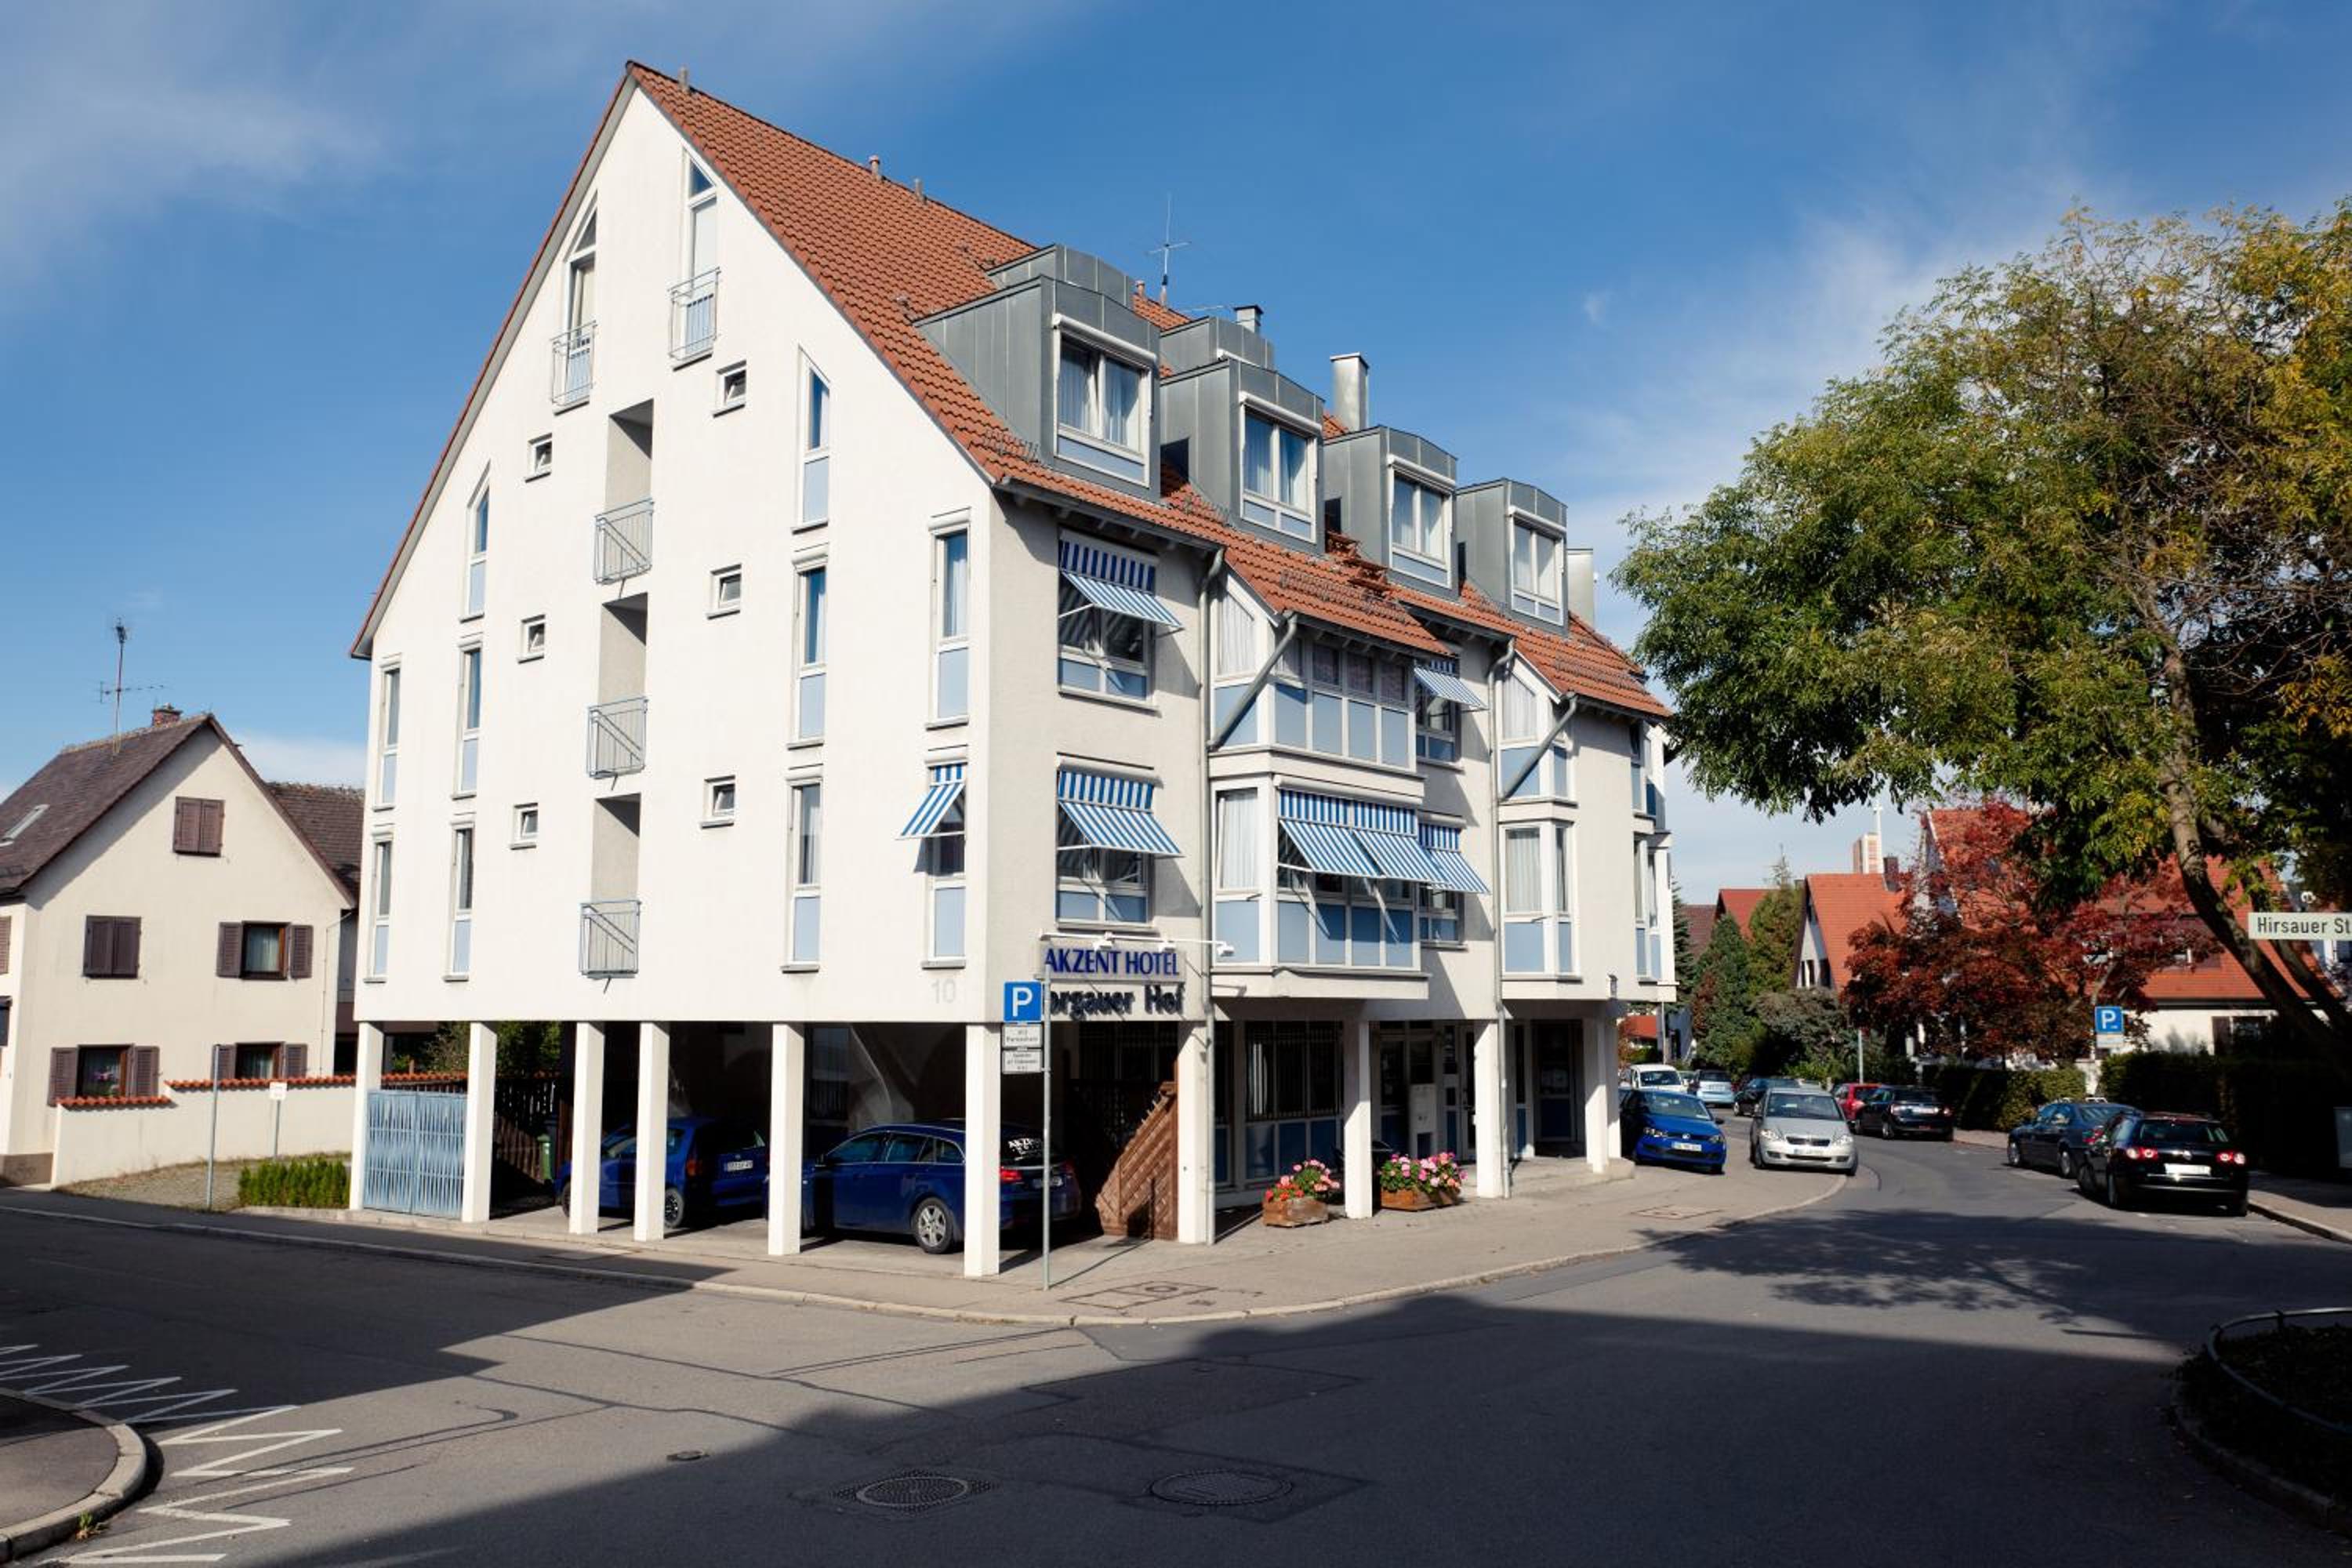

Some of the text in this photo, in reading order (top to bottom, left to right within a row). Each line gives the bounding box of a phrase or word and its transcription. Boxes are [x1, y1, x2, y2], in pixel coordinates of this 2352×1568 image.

[2257, 916, 2327, 934] Hirsauer
[1044, 948, 1180, 975] AKZENT HOTEL
[931, 978, 956, 1004] 10
[1012, 986, 1033, 1017] P
[1043, 982, 1185, 1021] orgauer Hof
[2101, 1009, 2116, 1029] P
